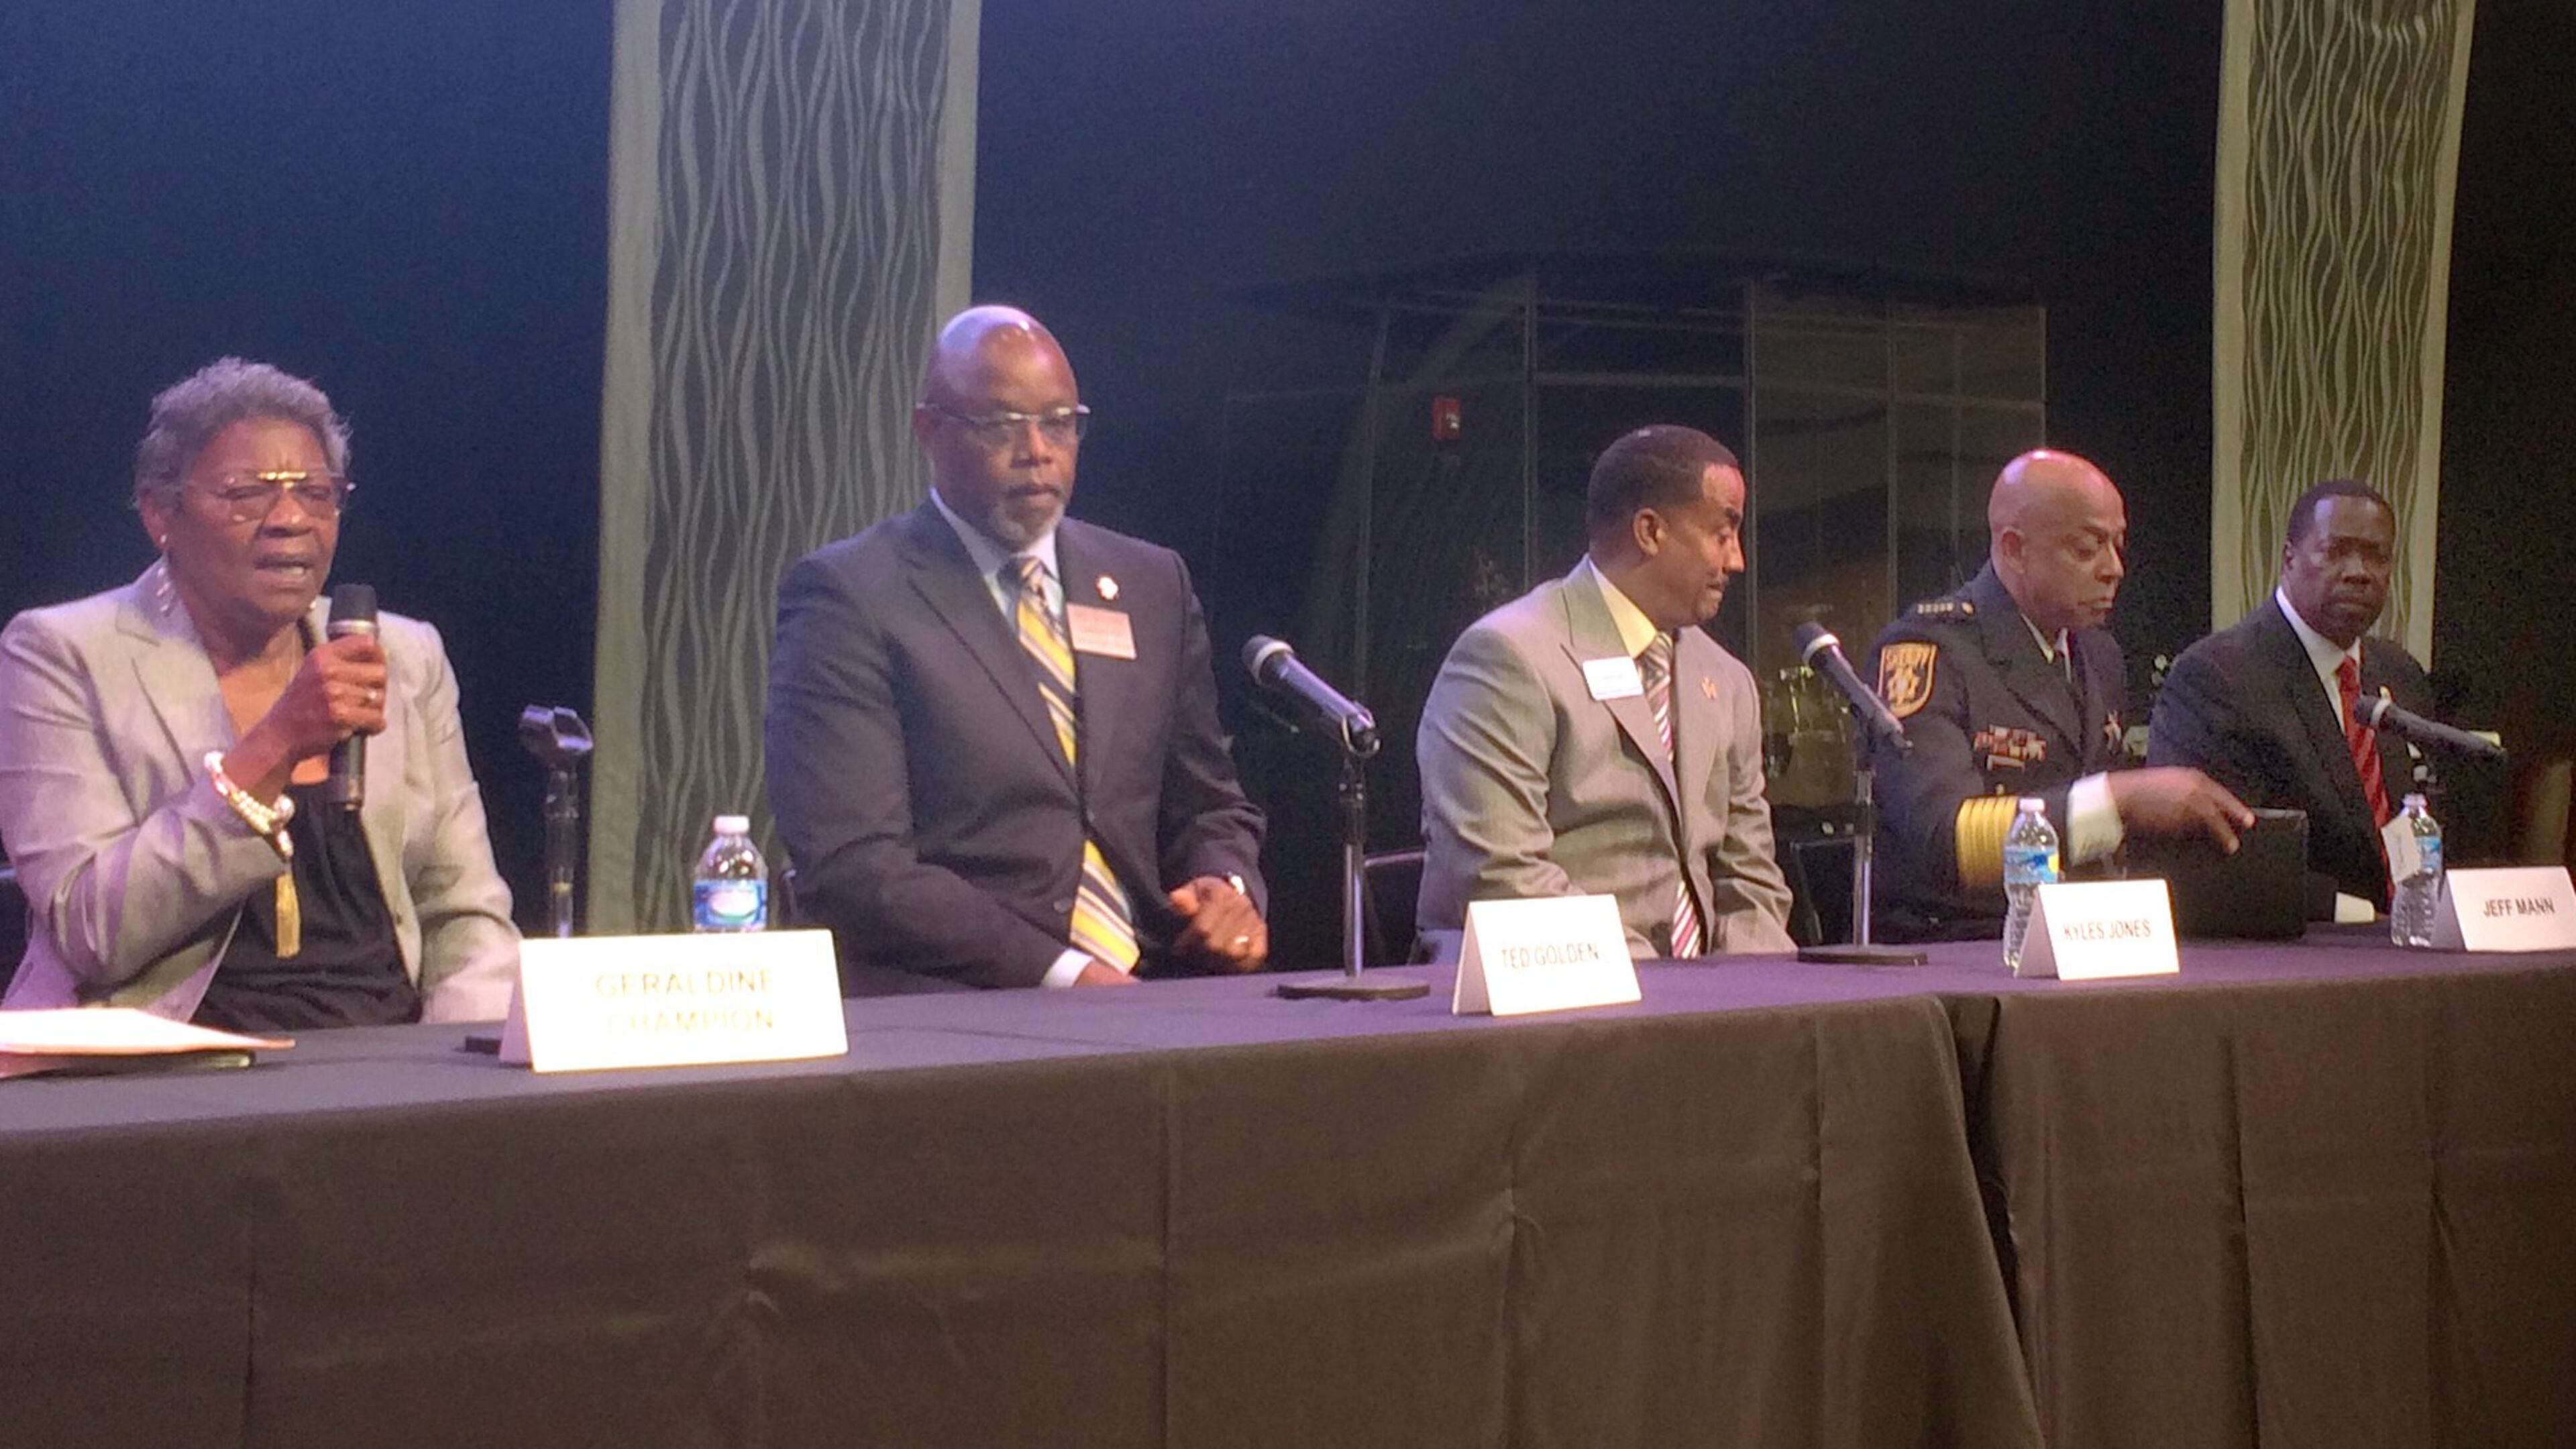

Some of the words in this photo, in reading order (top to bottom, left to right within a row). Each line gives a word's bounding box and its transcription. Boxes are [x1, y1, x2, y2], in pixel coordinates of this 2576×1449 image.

[2484, 899, 2513, 917] JEFF
[2515, 898, 2555, 915] MANN
[2063, 921, 2104, 941] KYLES
[2109, 919, 2151, 938] JONES
[1501, 947, 1529, 968] TED
[1535, 943, 1599, 965] GOLDEN
[594, 970, 773, 998] GERALDINE
